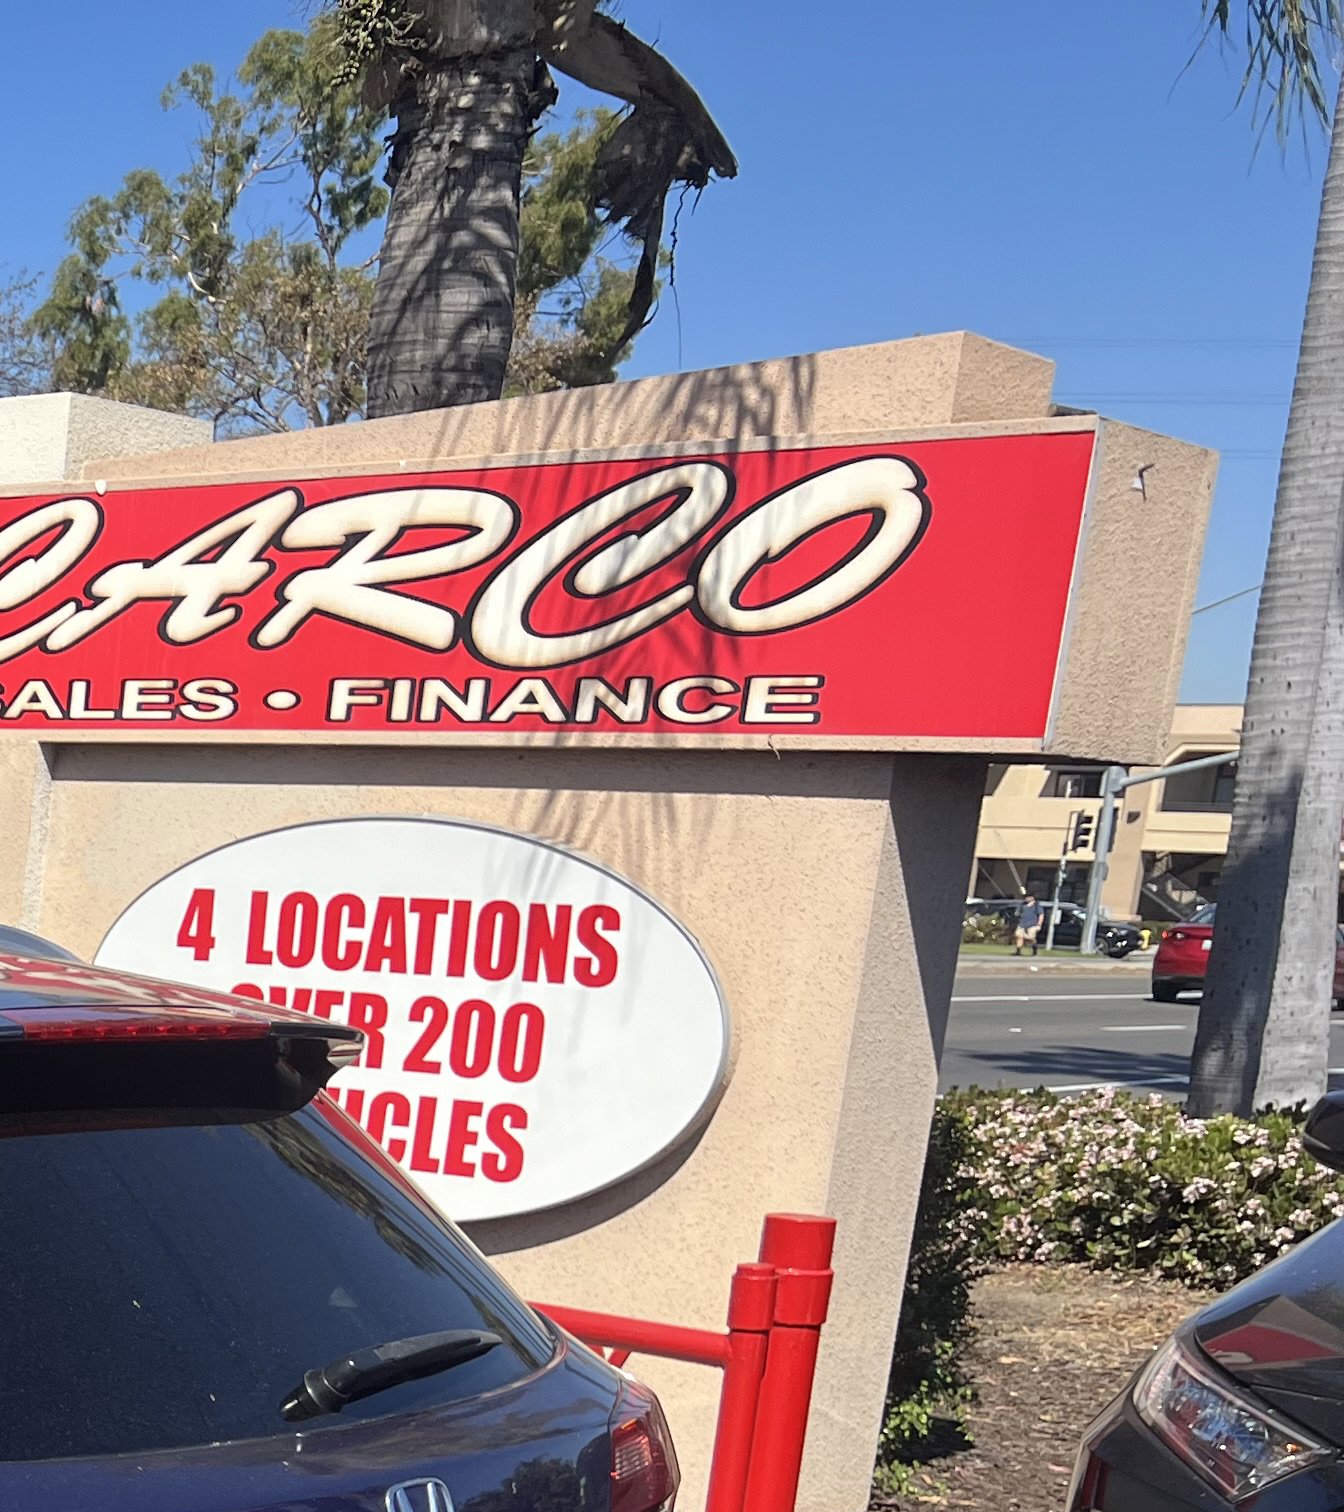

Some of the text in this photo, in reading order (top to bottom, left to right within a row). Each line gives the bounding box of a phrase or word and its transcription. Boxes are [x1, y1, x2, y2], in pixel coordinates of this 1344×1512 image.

[325, 675, 825, 724] FINANCE
[176, 888, 622, 988] 4 LOCATIONS
[402, 996, 546, 1083] 200
